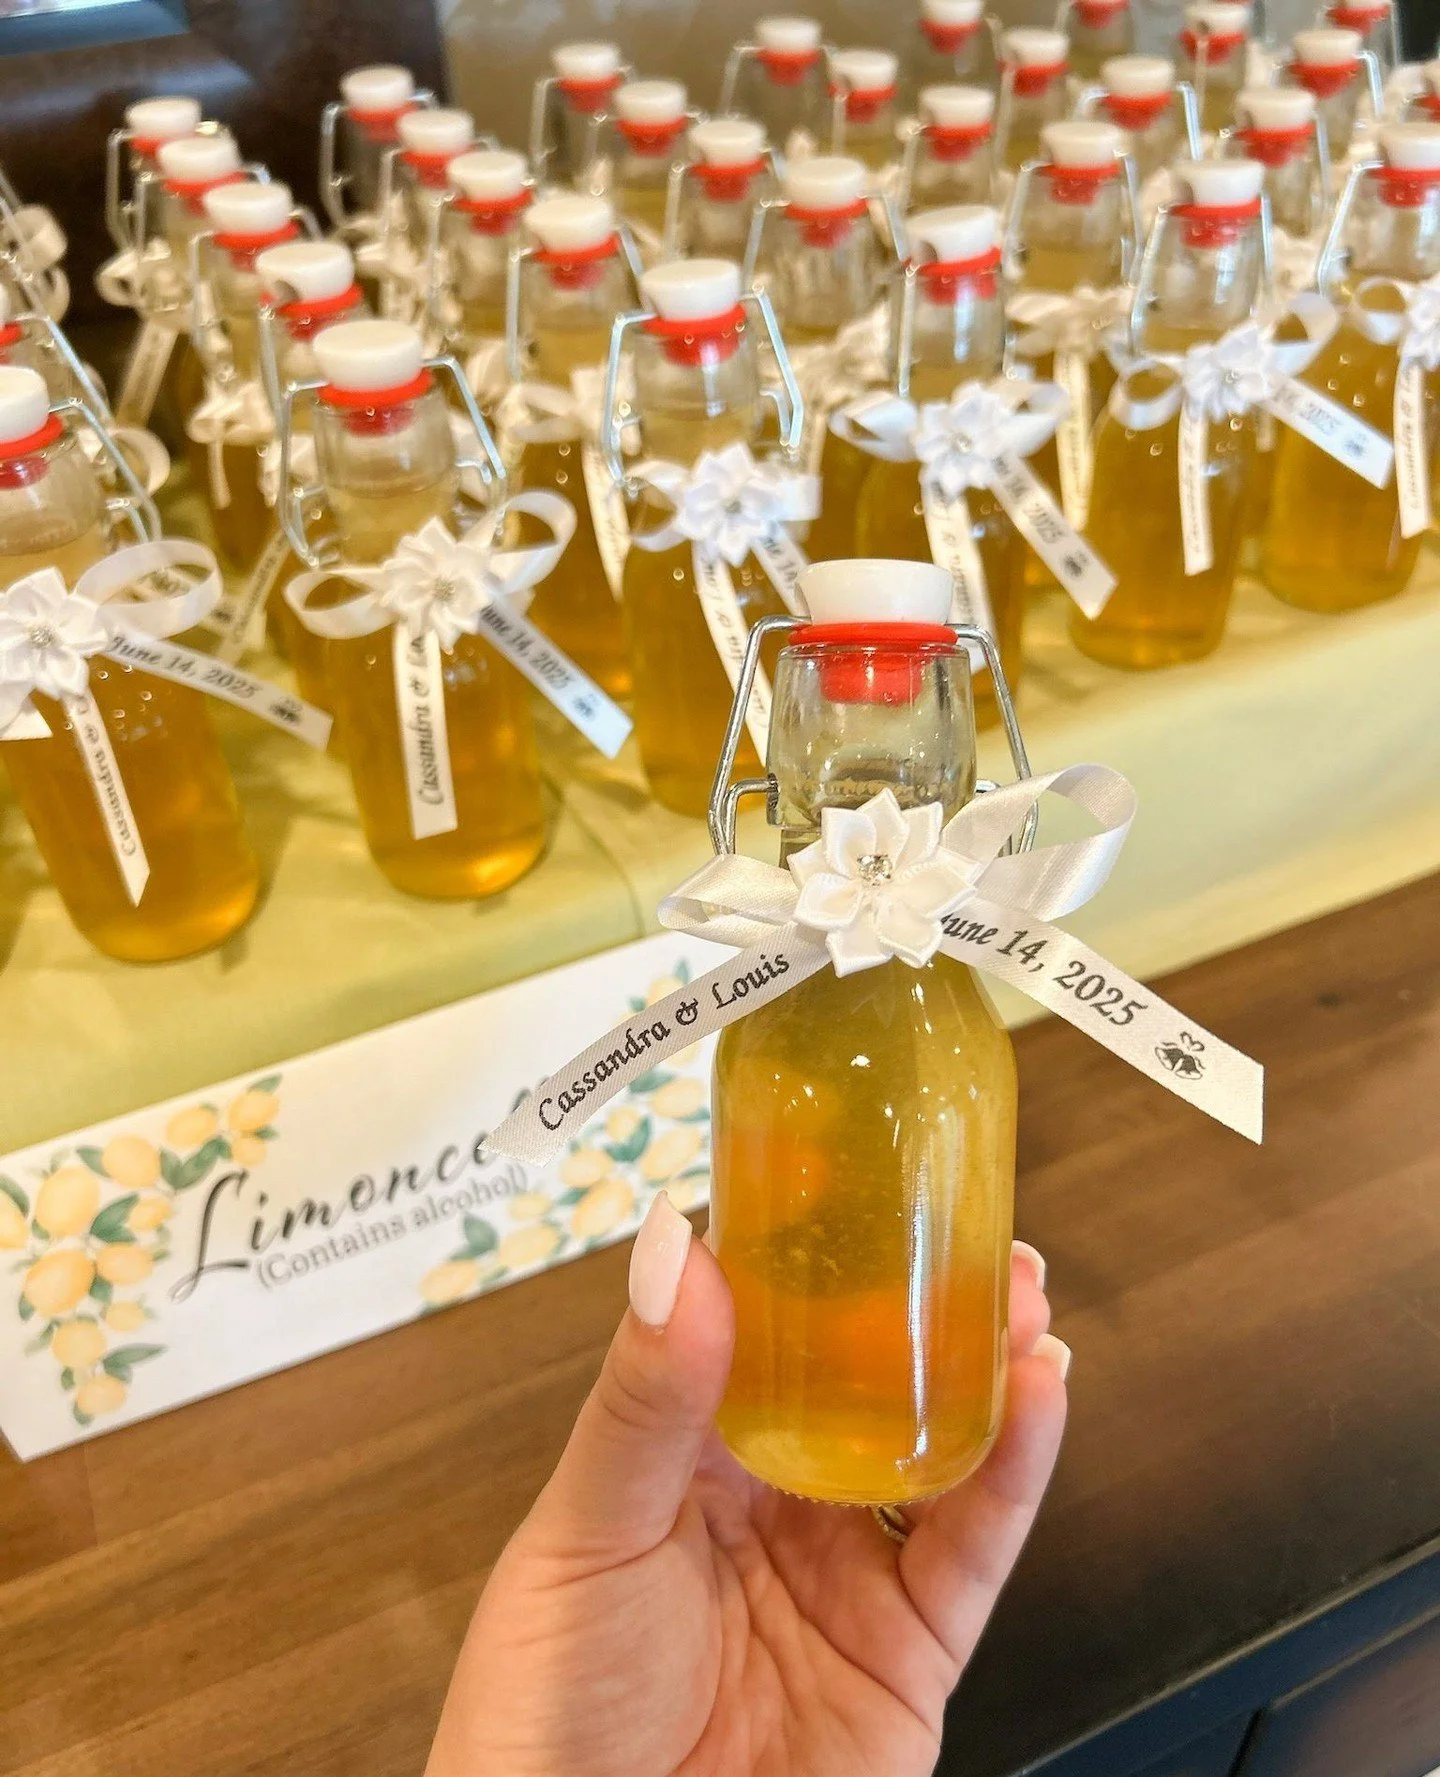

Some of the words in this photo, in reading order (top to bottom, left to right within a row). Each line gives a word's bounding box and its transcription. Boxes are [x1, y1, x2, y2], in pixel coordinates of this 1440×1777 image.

[201, 668, 266, 699] 2025
[530, 651, 572, 690] 2025
[414, 700, 445, 806] Cassandra
[995, 929, 1049, 973] 14,
[1051, 960, 1148, 1025] 2025
[538, 1027, 671, 1130] Cassandra
[675, 997, 699, 1026] &
[711, 952, 790, 1010] Louis
[168, 1077, 550, 1303] Limonce
[255, 1210, 408, 1290] (Contains
[413, 1162, 529, 1226] alcohol)
